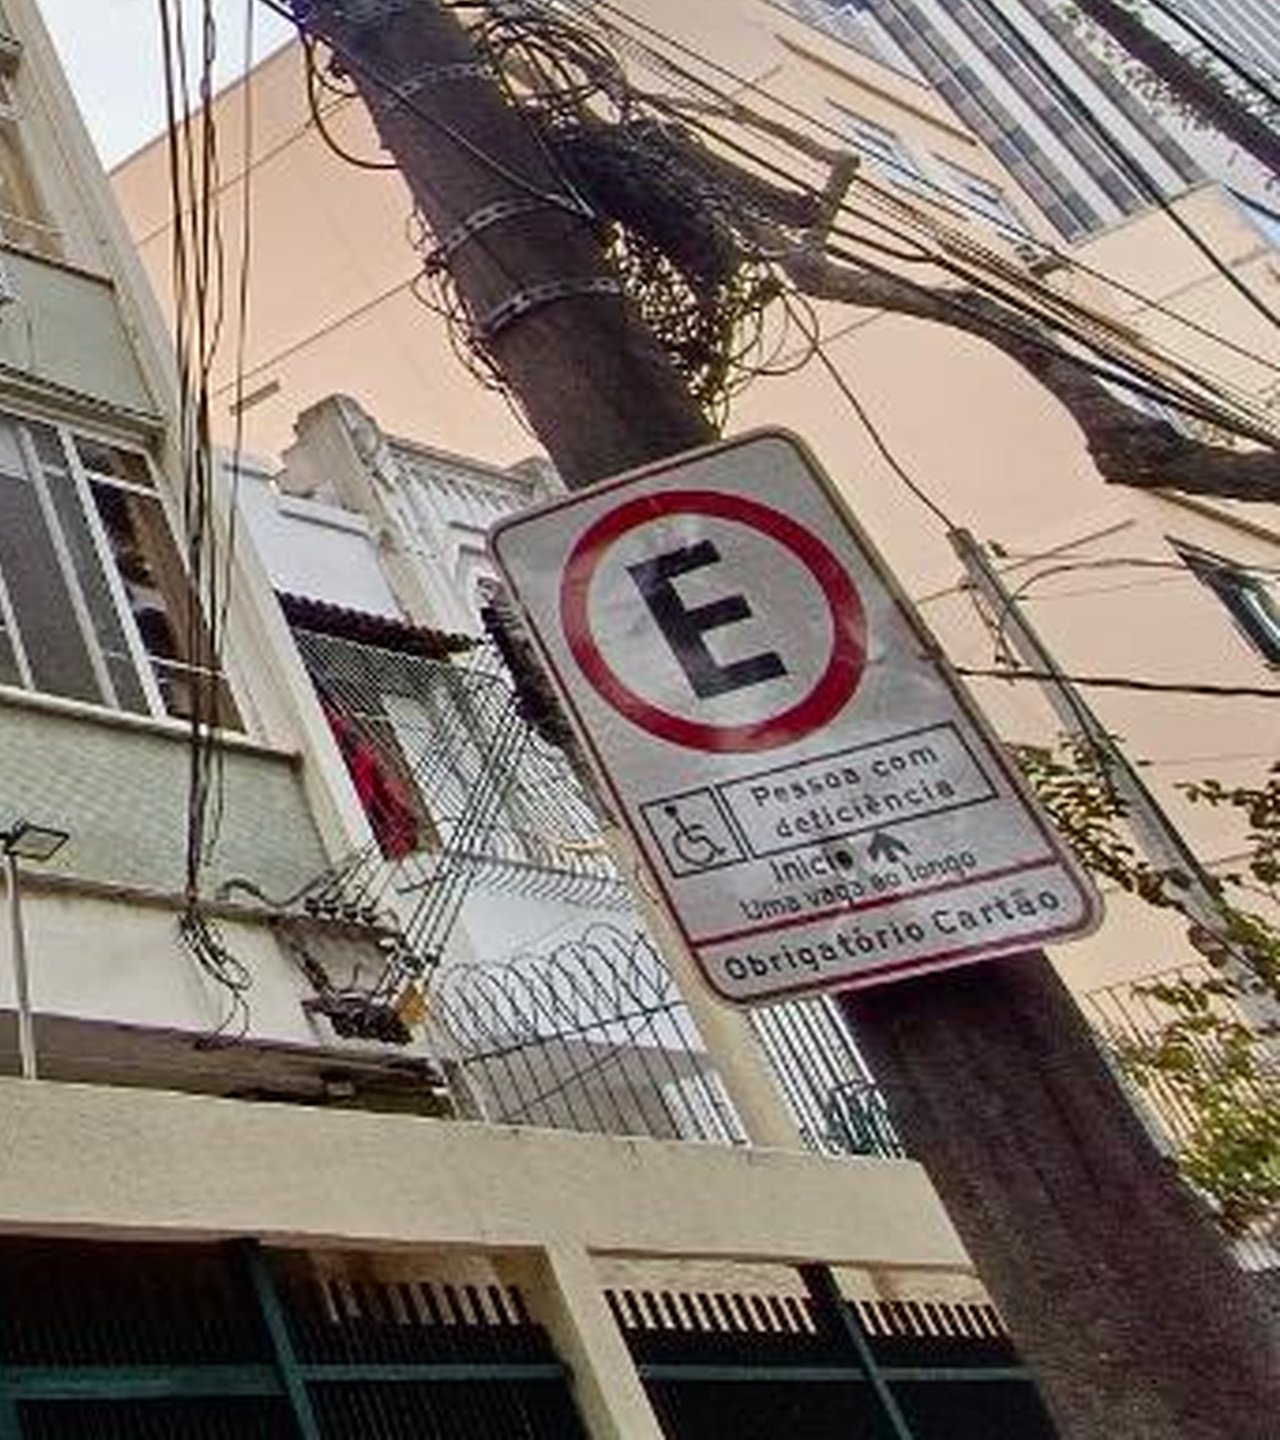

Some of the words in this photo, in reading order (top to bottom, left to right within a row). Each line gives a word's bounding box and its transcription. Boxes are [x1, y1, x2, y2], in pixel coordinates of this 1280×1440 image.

[627, 539, 788, 700] E
[751, 767, 860, 807] Pessoa
[871, 745, 939, 777] com
[740, 893, 802, 920] Uma
[806, 879, 866, 907] vaga
[870, 872, 903, 890] ao
[904, 849, 978, 883] longo
[724, 922, 926, 981] Obrigatório
[932, 887, 1061, 935] Cartão
